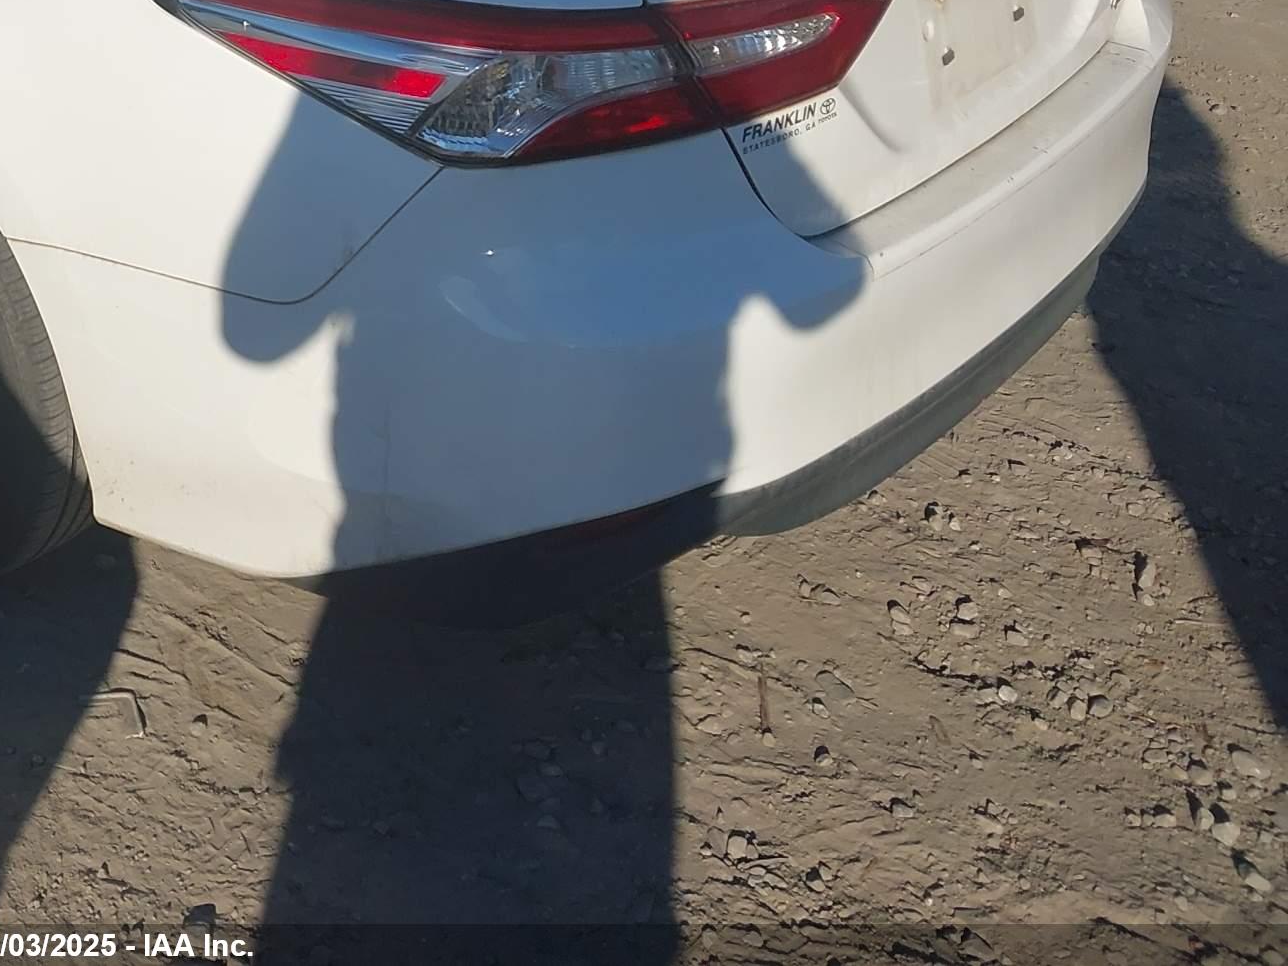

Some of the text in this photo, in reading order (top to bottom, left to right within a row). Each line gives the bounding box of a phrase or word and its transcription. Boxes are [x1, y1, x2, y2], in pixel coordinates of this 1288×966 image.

[742, 102, 817, 143] FRANKLIN
[818, 112, 837, 124] TOYOTA
[805, 122, 816, 131] GA
